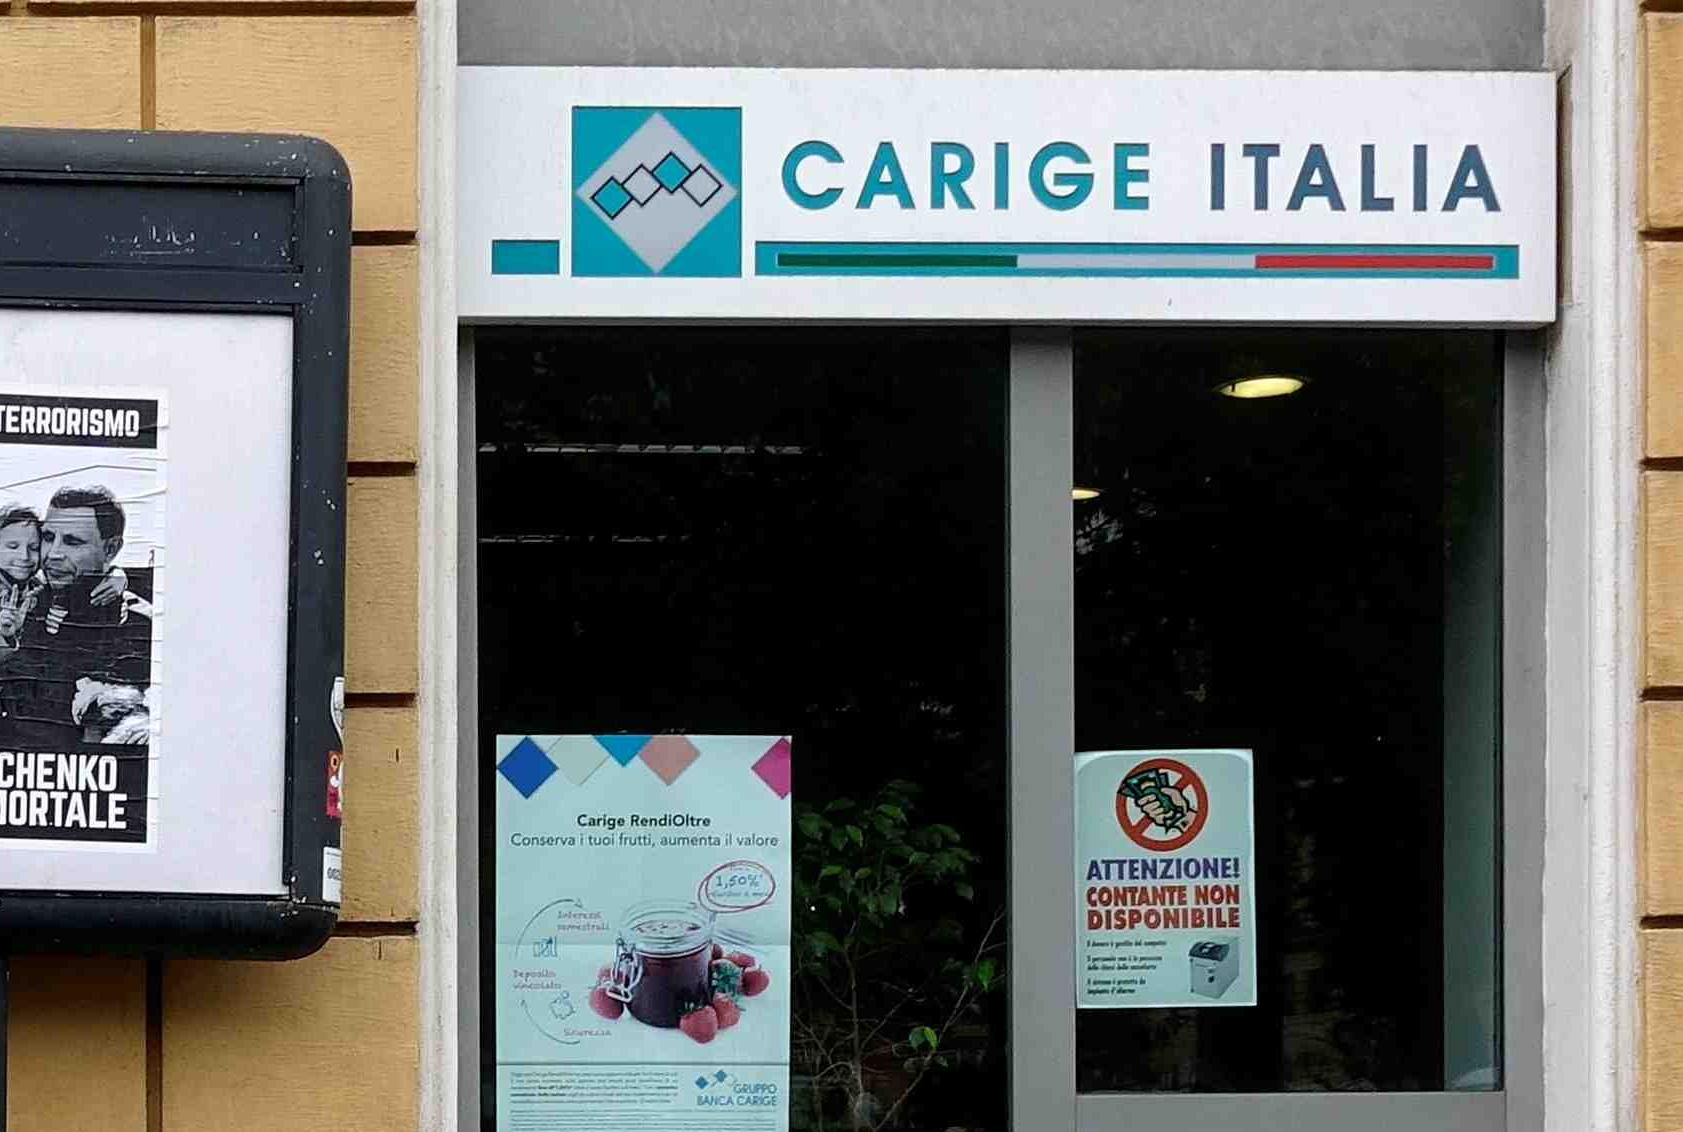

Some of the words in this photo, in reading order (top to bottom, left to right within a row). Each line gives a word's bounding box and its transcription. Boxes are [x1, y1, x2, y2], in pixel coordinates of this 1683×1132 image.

[780, 140, 1150, 213] CARIGE
[1210, 142, 1502, 213] ITALIA
[577, 814, 626, 831] Carige
[630, 814, 712, 828] RendiOltre
[510, 833, 576, 847] Conserva
[588, 833, 615, 847] tuoi
[618, 832, 656, 848] frutti,
[660, 834, 721, 847] aumenta
[725, 833, 733, 847] il
[737, 833, 779, 847] valore
[1086, 857, 1241, 881] ATTENZIONE!
[1086, 886, 1188, 908] CONTANTE
[1194, 884, 1240, 906] NON
[1087, 906, 1241, 931] DISPONIBILE
[733, 1083, 778, 1095] GRUPPO
[697, 1095, 735, 1107] BANCA
[736, 1095, 778, 1107] CARIGE
